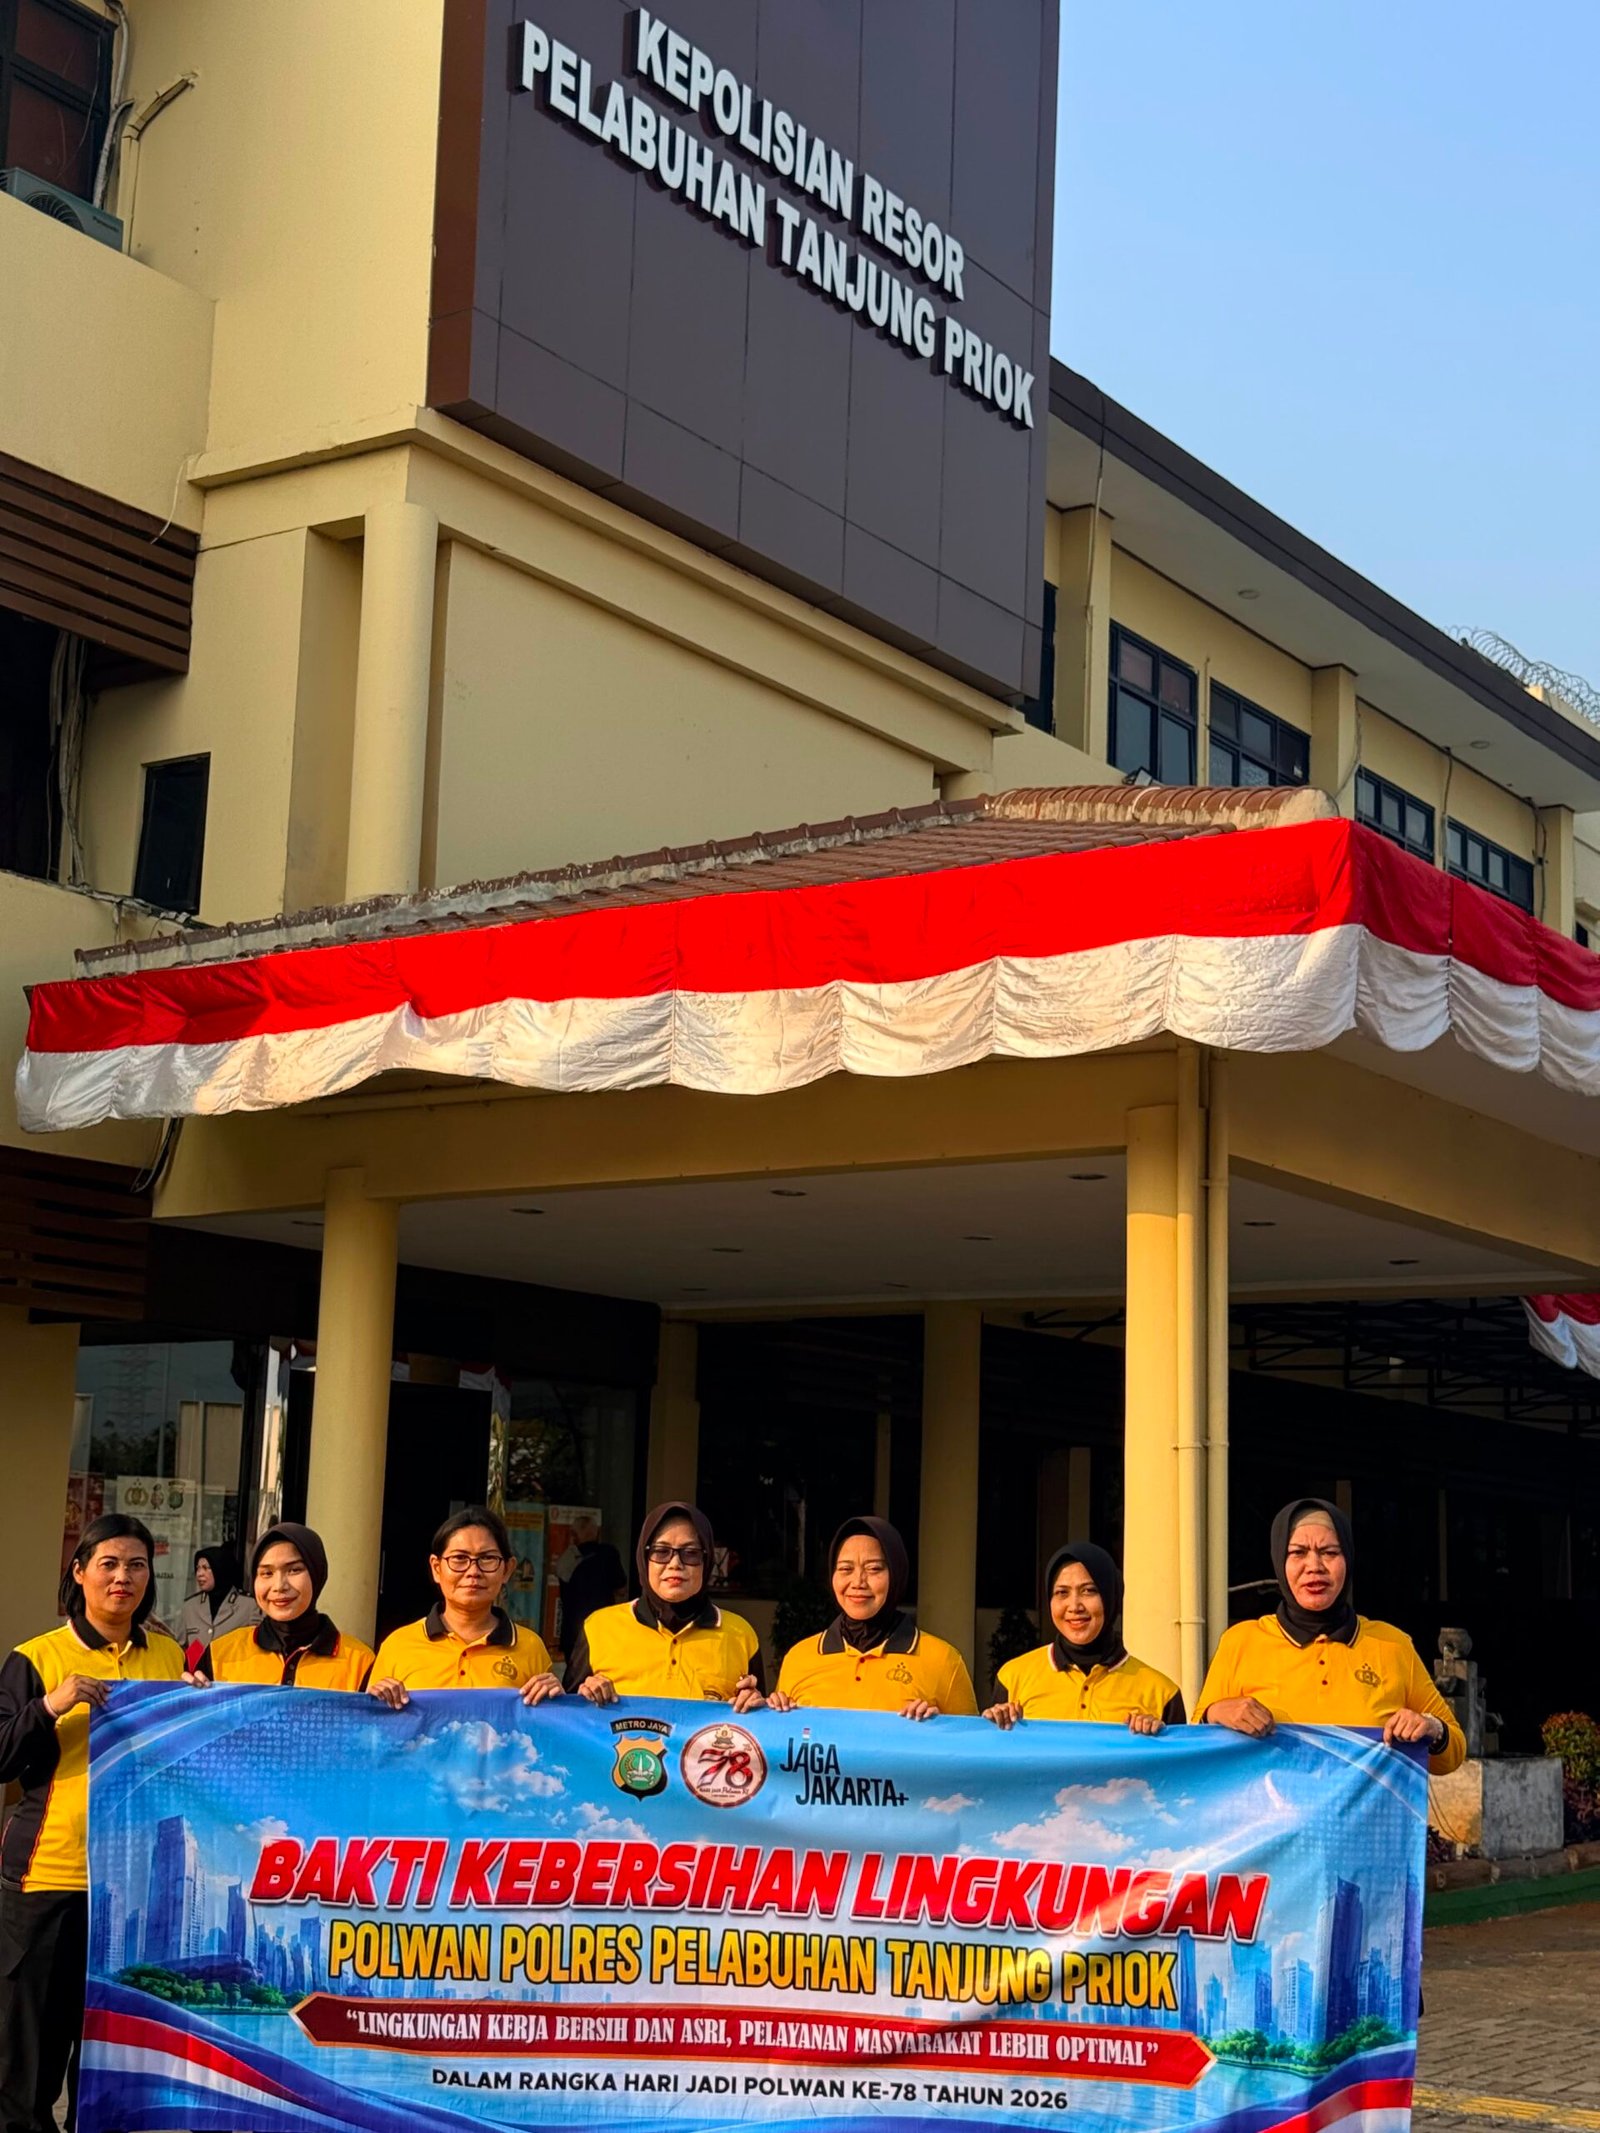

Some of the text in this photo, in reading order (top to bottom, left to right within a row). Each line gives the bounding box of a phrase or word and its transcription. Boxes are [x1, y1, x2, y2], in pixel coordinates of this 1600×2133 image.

[637, 7, 964, 301] KEPOLISIAN RESOR
[522, 19, 1035, 429] PELABUHAN TANJUNG PRIOK
[614, 1721, 669, 1735] METRO JAYA
[779, 1736, 841, 1776] JAGA
[696, 1748, 754, 1789] 78
[249, 1837, 1270, 1944] BAKTI KEBERSIHAN LINGKUNGAN
[328, 1920, 1179, 2011] POLWAN POLRES PELABUHAN TANJUNG PRIOK
[346, 2009, 1160, 2067] “LINGKUNGAN KERJA BERSIH DAN ASRI, PELAYANAN MASYARAKAT LEBIH OPTIMAL”
[432, 2068, 1069, 2110] DALAM RANGKA HARI JADI POLWAN KE-78 TAHUN 2026
